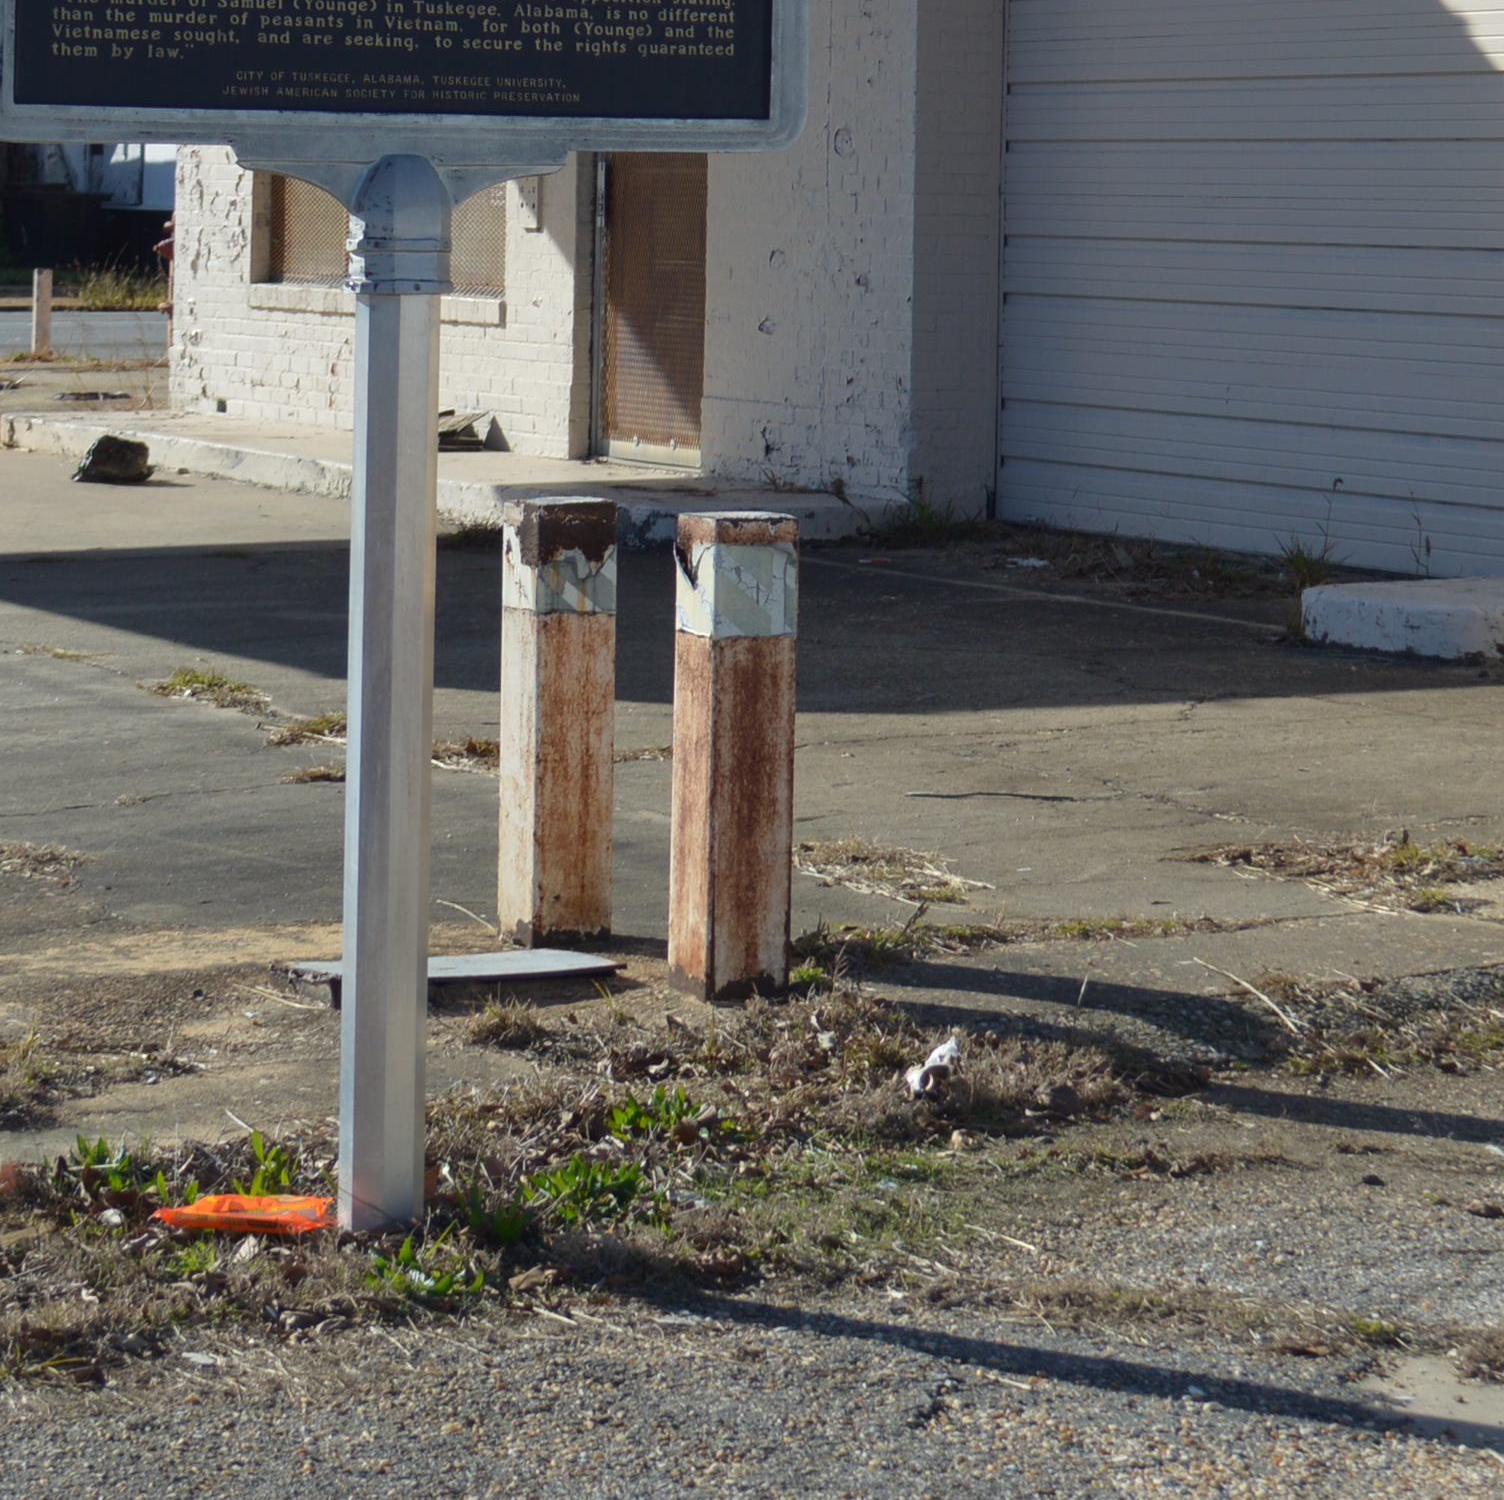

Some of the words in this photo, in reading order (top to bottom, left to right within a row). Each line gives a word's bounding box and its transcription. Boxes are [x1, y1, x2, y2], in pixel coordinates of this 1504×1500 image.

[412, 0, 500, 18] Tuskegee,
[514, 3, 593, 20] Alabama,
[606, 6, 620, 20] is
[628, 9, 648, 20] no
[657, 7, 735, 23] different
[52, 23, 160, 40] Vietnamese
[174, 29, 239, 45] sought,
[257, 30, 290, 44] and
[302, 33, 332, 45] are
[344, 33, 418, 50] seeking,
[434, 34, 452, 48] to
[462, 38, 522, 51] secure
[534, 37, 563, 51] the
[575, 38, 626, 55] rights
[637, 42, 734, 56] guaranteed
[51, 42, 97, 57] them
[111, 42, 134, 59] by
[148, 43, 194, 59] law."
[236, 70, 263, 80] CITY
[270, 71, 284, 80] OF
[291, 71, 355, 84] TUSKEGEE,
[432, 75, 490, 86] TUSKEGEE
[496, 76, 566, 88] UNIVERSITY,
[222, 85, 268, 95] JEWISH
[276, 87, 337, 97] AMERICAN
[345, 88, 395, 98] SOCIETY
[403, 89, 425, 99] FOR
[432, 90, 486, 100] HISTORIC
[493, 91, 580, 102] PRESERVATION
